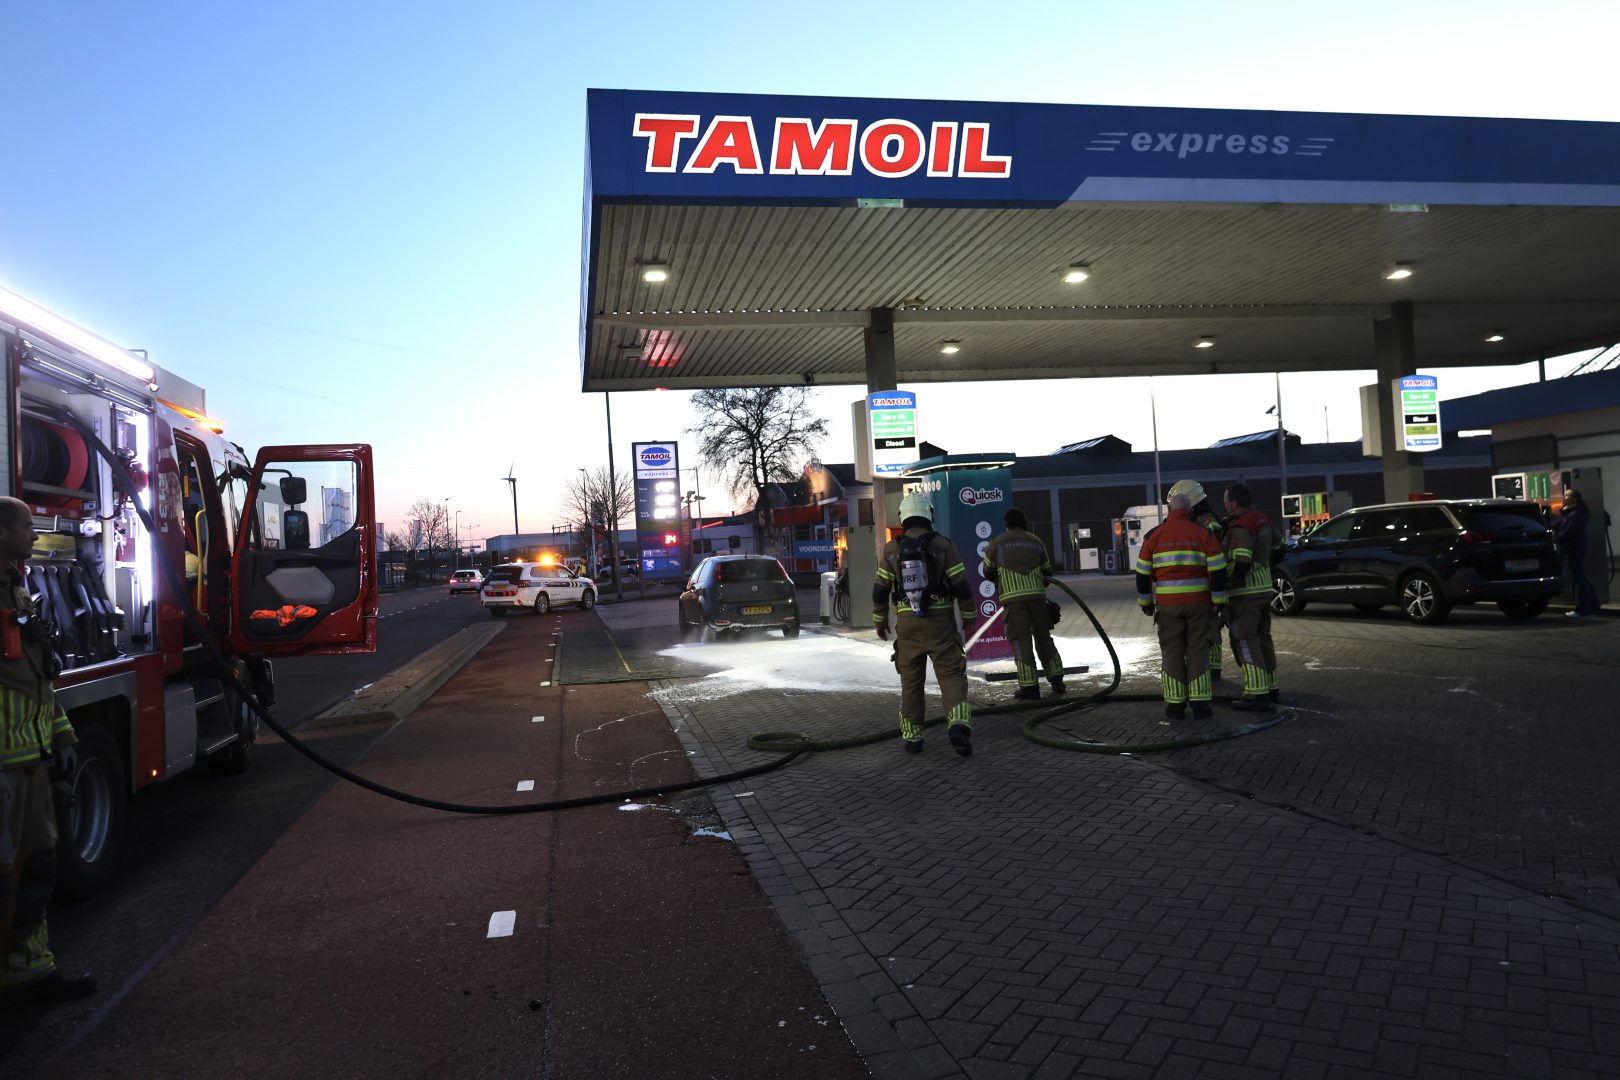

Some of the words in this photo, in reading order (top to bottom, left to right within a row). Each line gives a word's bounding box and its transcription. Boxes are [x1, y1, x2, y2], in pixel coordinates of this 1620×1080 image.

[632, 112, 1013, 179] TAMOIL
[1130, 129, 1291, 158] express
[873, 398, 912, 406] TAMOIL
[1514, 478, 1522, 489] 2
[959, 487, 1003, 505] Quiosk
